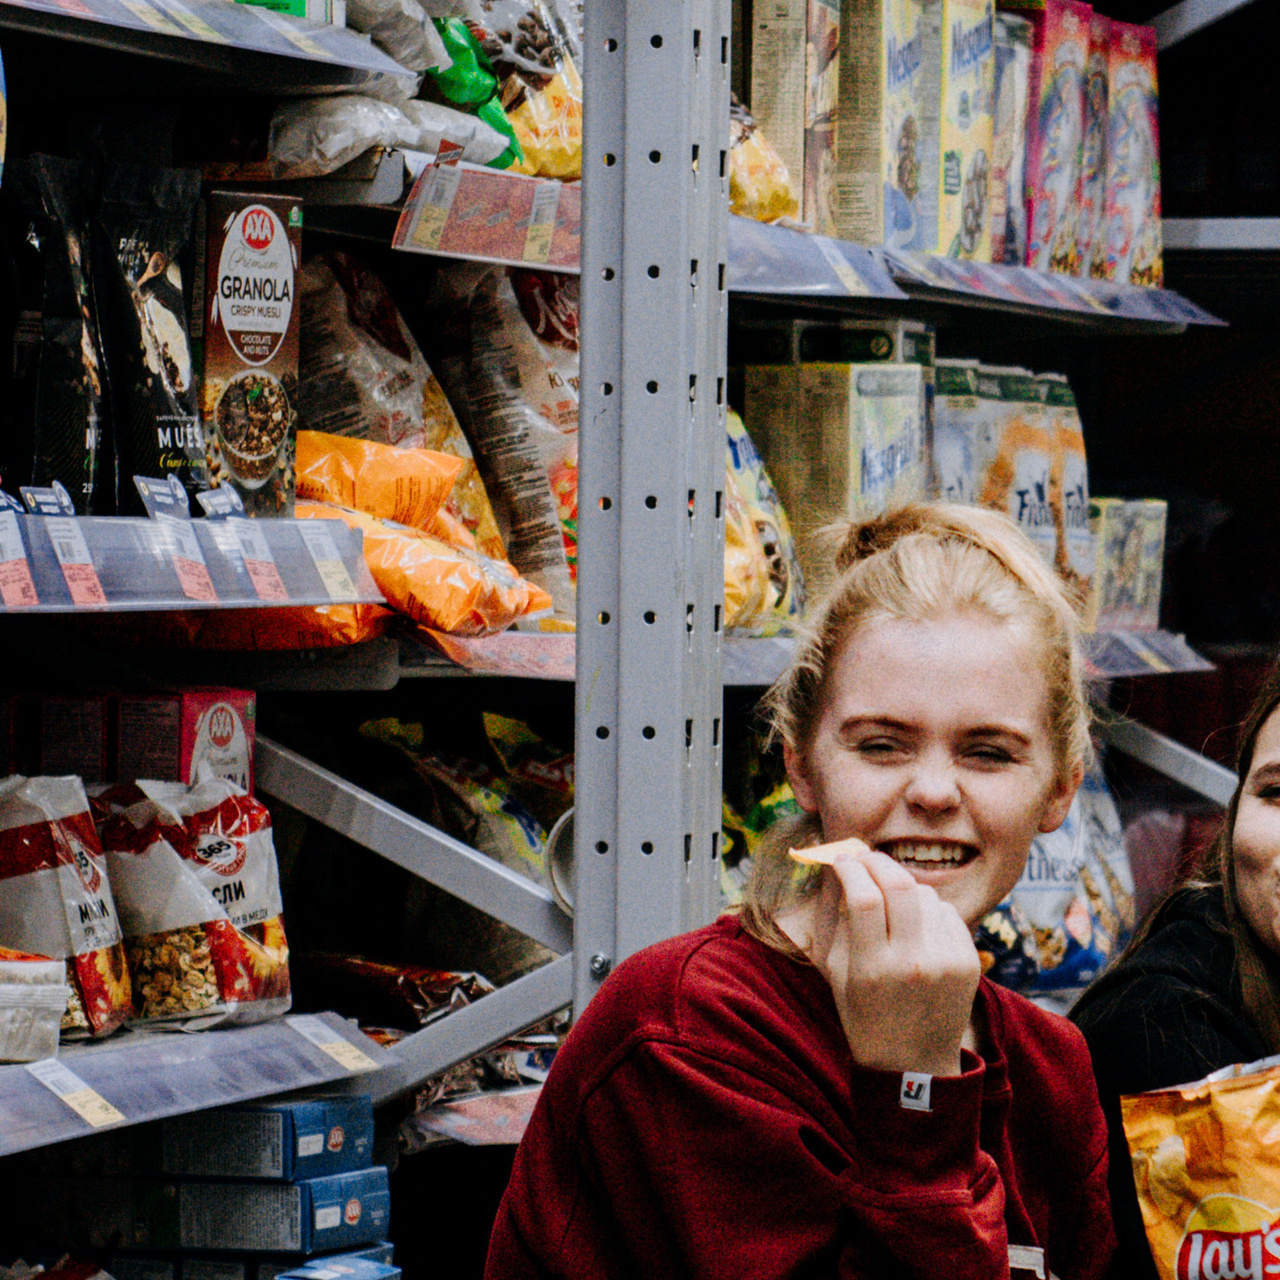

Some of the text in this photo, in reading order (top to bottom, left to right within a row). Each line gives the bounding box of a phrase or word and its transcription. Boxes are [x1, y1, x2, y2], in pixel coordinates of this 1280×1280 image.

[244, 212, 272, 241] AXA
[228, 246, 278, 271] Premium
[220, 275, 291, 303] GRANOLA
[230, 304, 281, 319] CRISPY MUESLI
[240, 334, 272, 346] CHOCOLATE
[243, 344, 255, 355] AND
[197, 840, 232, 859] 365
